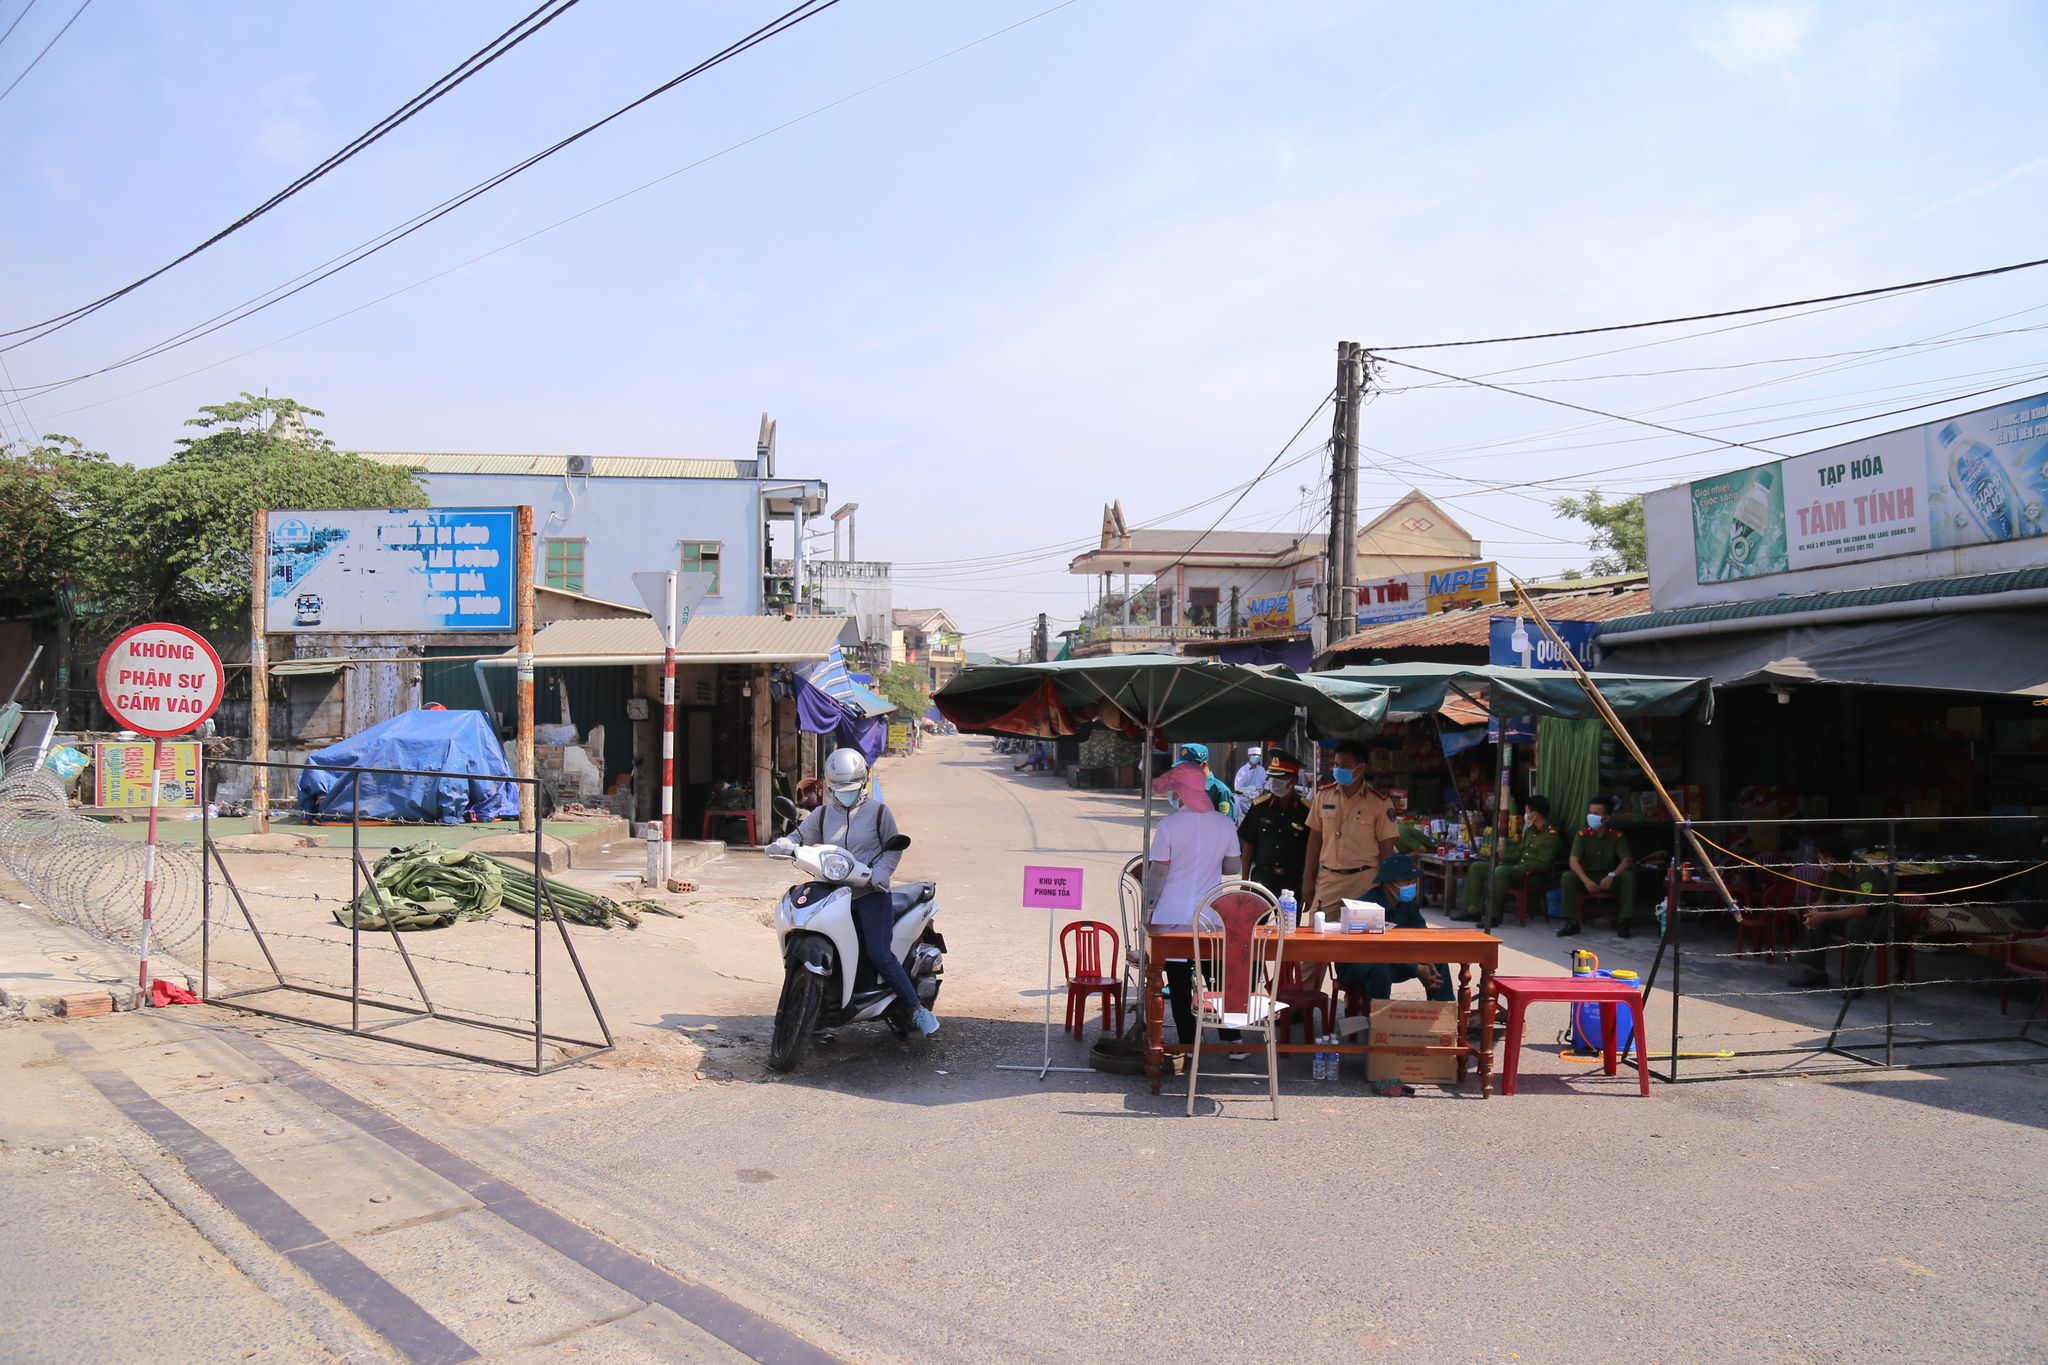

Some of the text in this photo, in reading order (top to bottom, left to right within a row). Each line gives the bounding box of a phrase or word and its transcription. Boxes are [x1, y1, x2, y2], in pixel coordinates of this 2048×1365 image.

[1818, 454, 1884, 489] TẠP HÓA
[1796, 486, 1915, 536] TÂM TÍNH
[1373, 578, 1409, 604] TÍN
[1427, 566, 1490, 596] MPE
[1250, 594, 1289, 615] MPE
[129, 640, 194, 660] KHÔNG
[119, 668, 206, 693] PHẬN SỰ
[117, 690, 203, 714] CẤM VÀO
[125, 746, 149, 767] CHÁO
[185, 780, 196, 800] Lan
[1034, 888, 1057, 897] PHONG
[1053, 878, 1067, 887] VỰC
